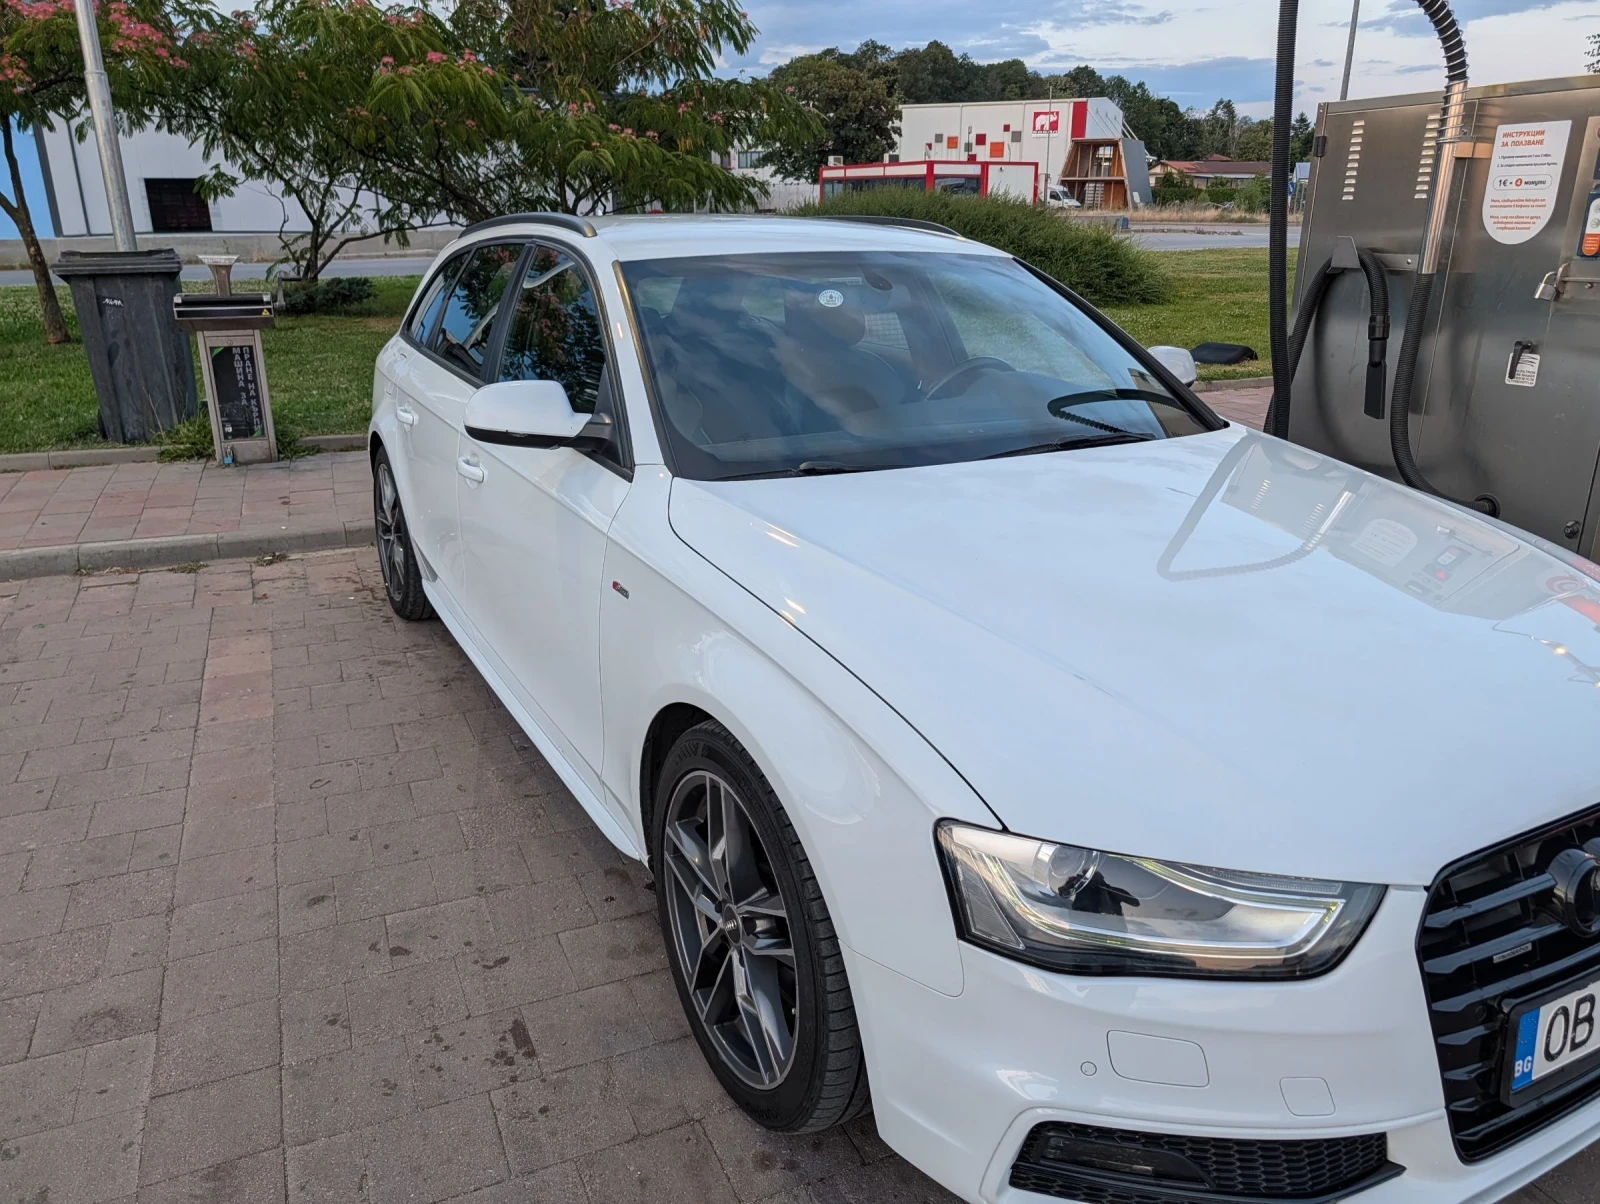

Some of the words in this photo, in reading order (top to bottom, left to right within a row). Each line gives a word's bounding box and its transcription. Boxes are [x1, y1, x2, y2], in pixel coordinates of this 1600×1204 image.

[1502, 129, 1546, 139] ИНСТРУКЦИИ
[1510, 138, 1545, 147] ПОЛЗВАНЕ
[1498, 179, 1508, 188] 1€
[243, 346, 253, 380] ПРАНЕ
[232, 347, 245, 387] МАШИНА
[240, 392, 248, 406] ЗА
[248, 383, 256, 396] НА
[250, 399, 262, 431] КЪРПИ
[1514, 1055, 1533, 1078] BG
